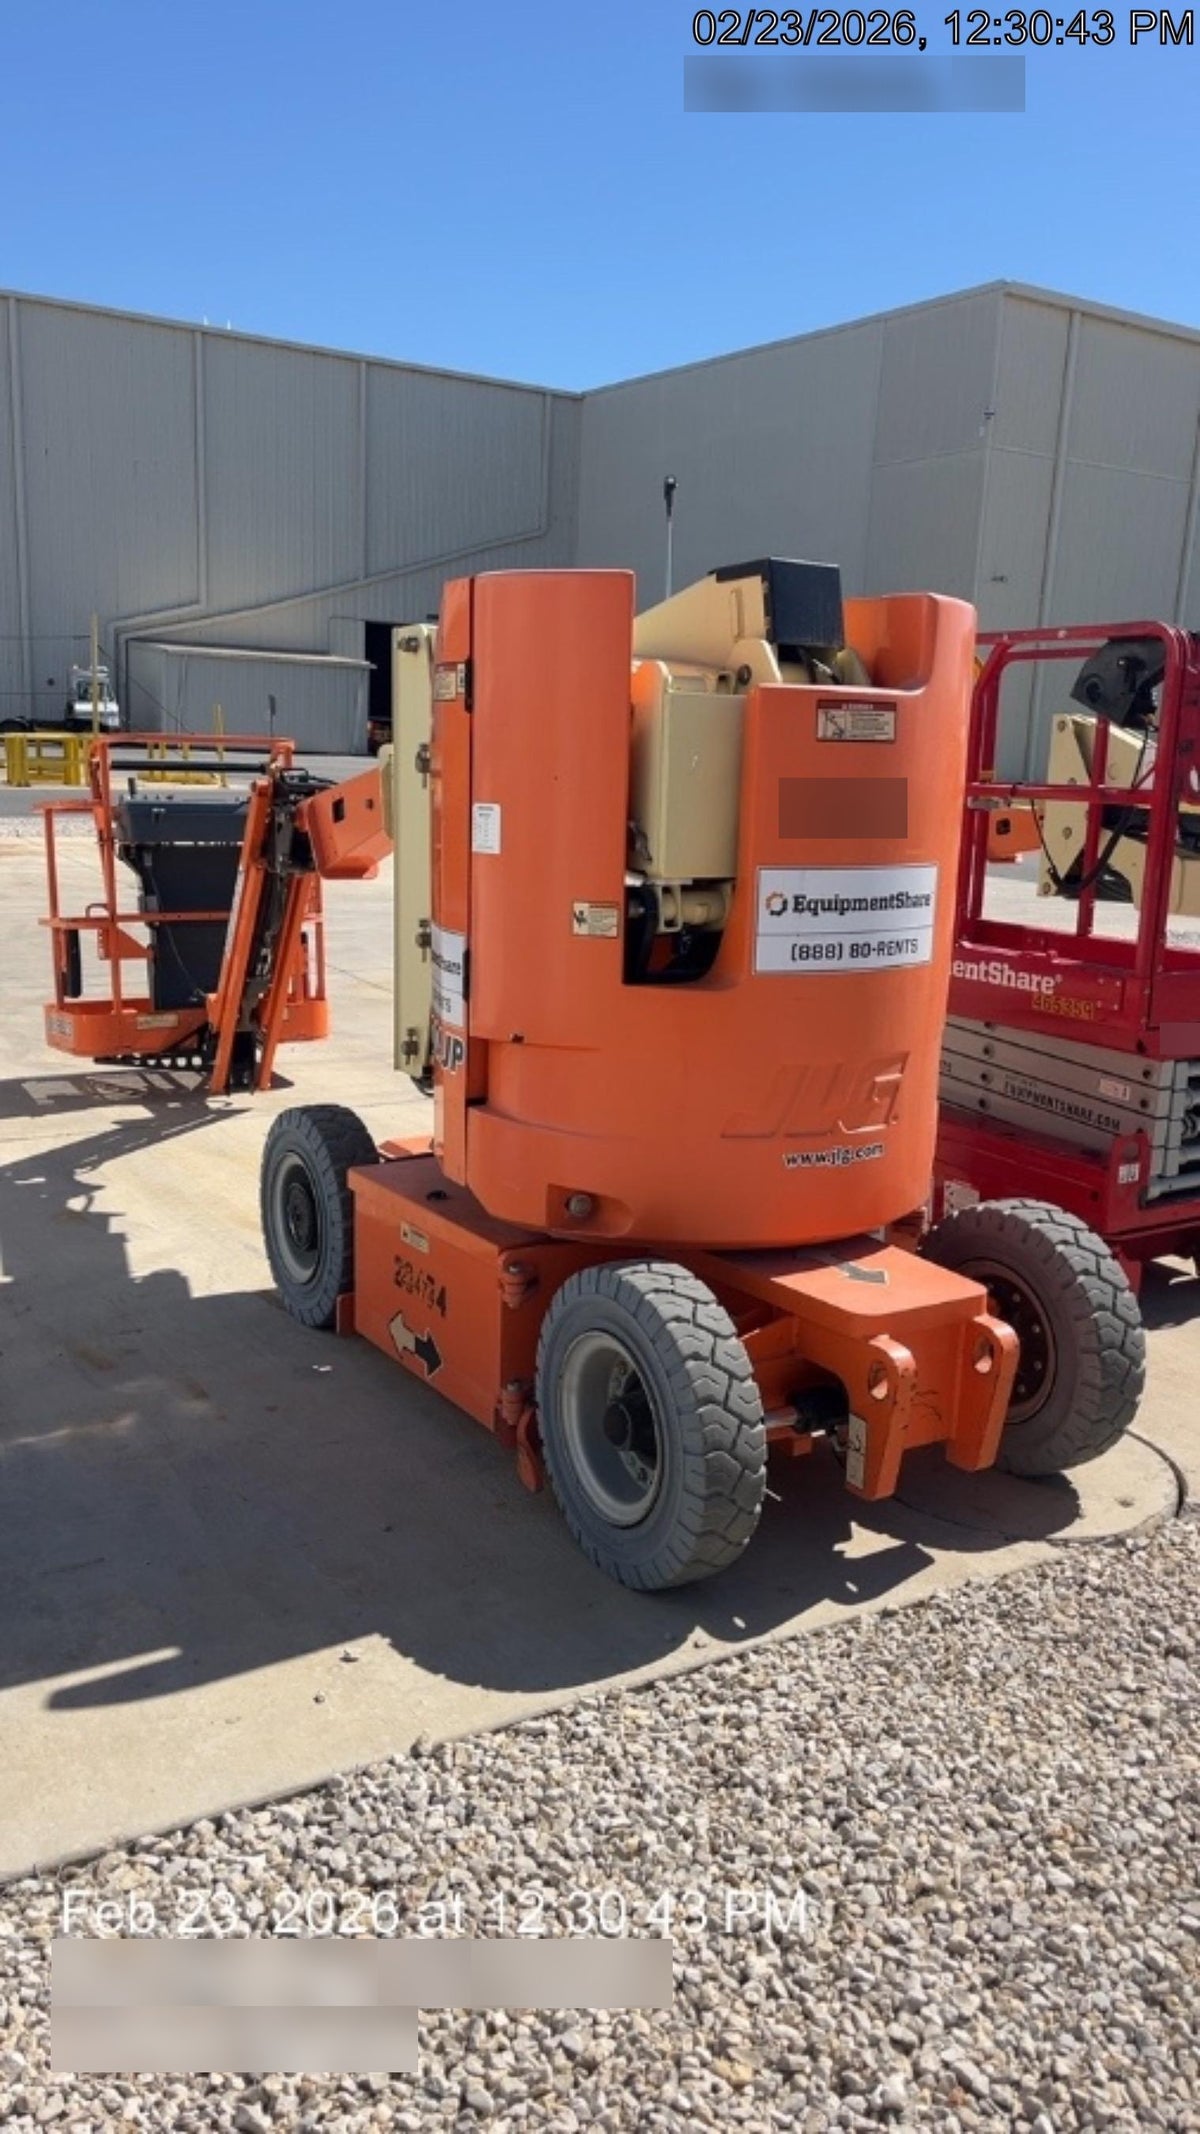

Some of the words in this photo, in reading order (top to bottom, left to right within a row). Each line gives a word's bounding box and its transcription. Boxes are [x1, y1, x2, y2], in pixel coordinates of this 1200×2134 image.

[791, 891, 931, 916] EquipmentShare
[791, 942, 843, 962] (888)
[849, 939, 919, 960] 80-RENTS
[952, 959, 1056, 995] entShare
[784, 1143, 885, 1168] www.jlg.com
